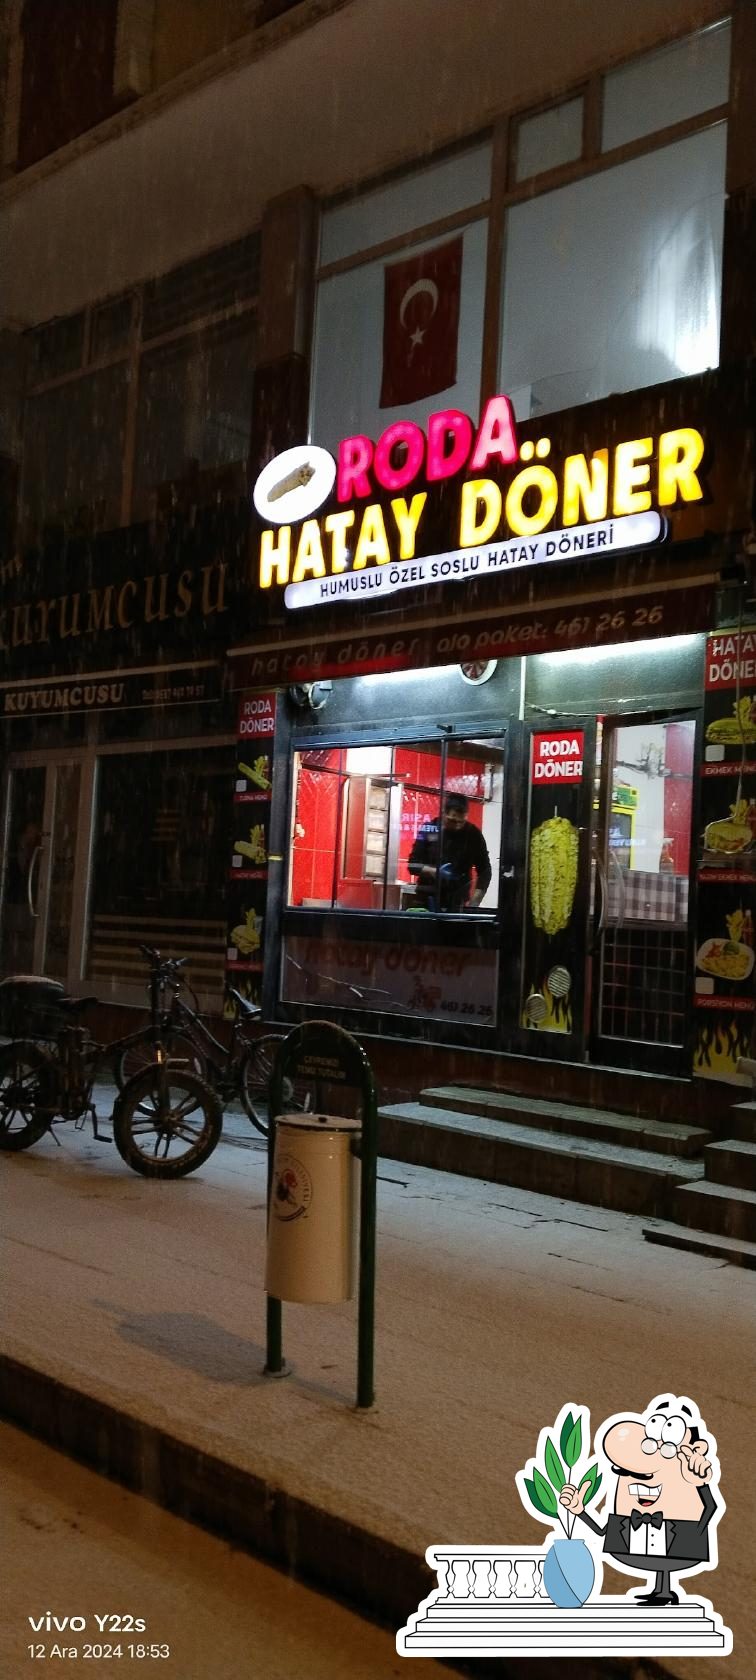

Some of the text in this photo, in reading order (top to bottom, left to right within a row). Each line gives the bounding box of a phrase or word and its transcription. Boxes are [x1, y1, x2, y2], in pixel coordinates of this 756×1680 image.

[337, 395, 517, 503] RODA
[259, 427, 705, 589] HATAY DÖNER
[319, 523, 615, 598] HUMUSLU ÖZEL SOSLU HATAY DÖNERİ
[436, 628, 470, 652] alo
[474, 618, 548, 650] paket:
[553, 611, 590, 638] 461
[595, 610, 626, 632] 26
[632, 605, 664, 627] 26
[4, 682, 125, 712] KUYUMCUSU
[243, 699, 272, 715] RODA
[239, 716, 274, 734] DÖNER
[539, 740, 580, 758] RODA
[534, 757, 583, 780] DÖNER
